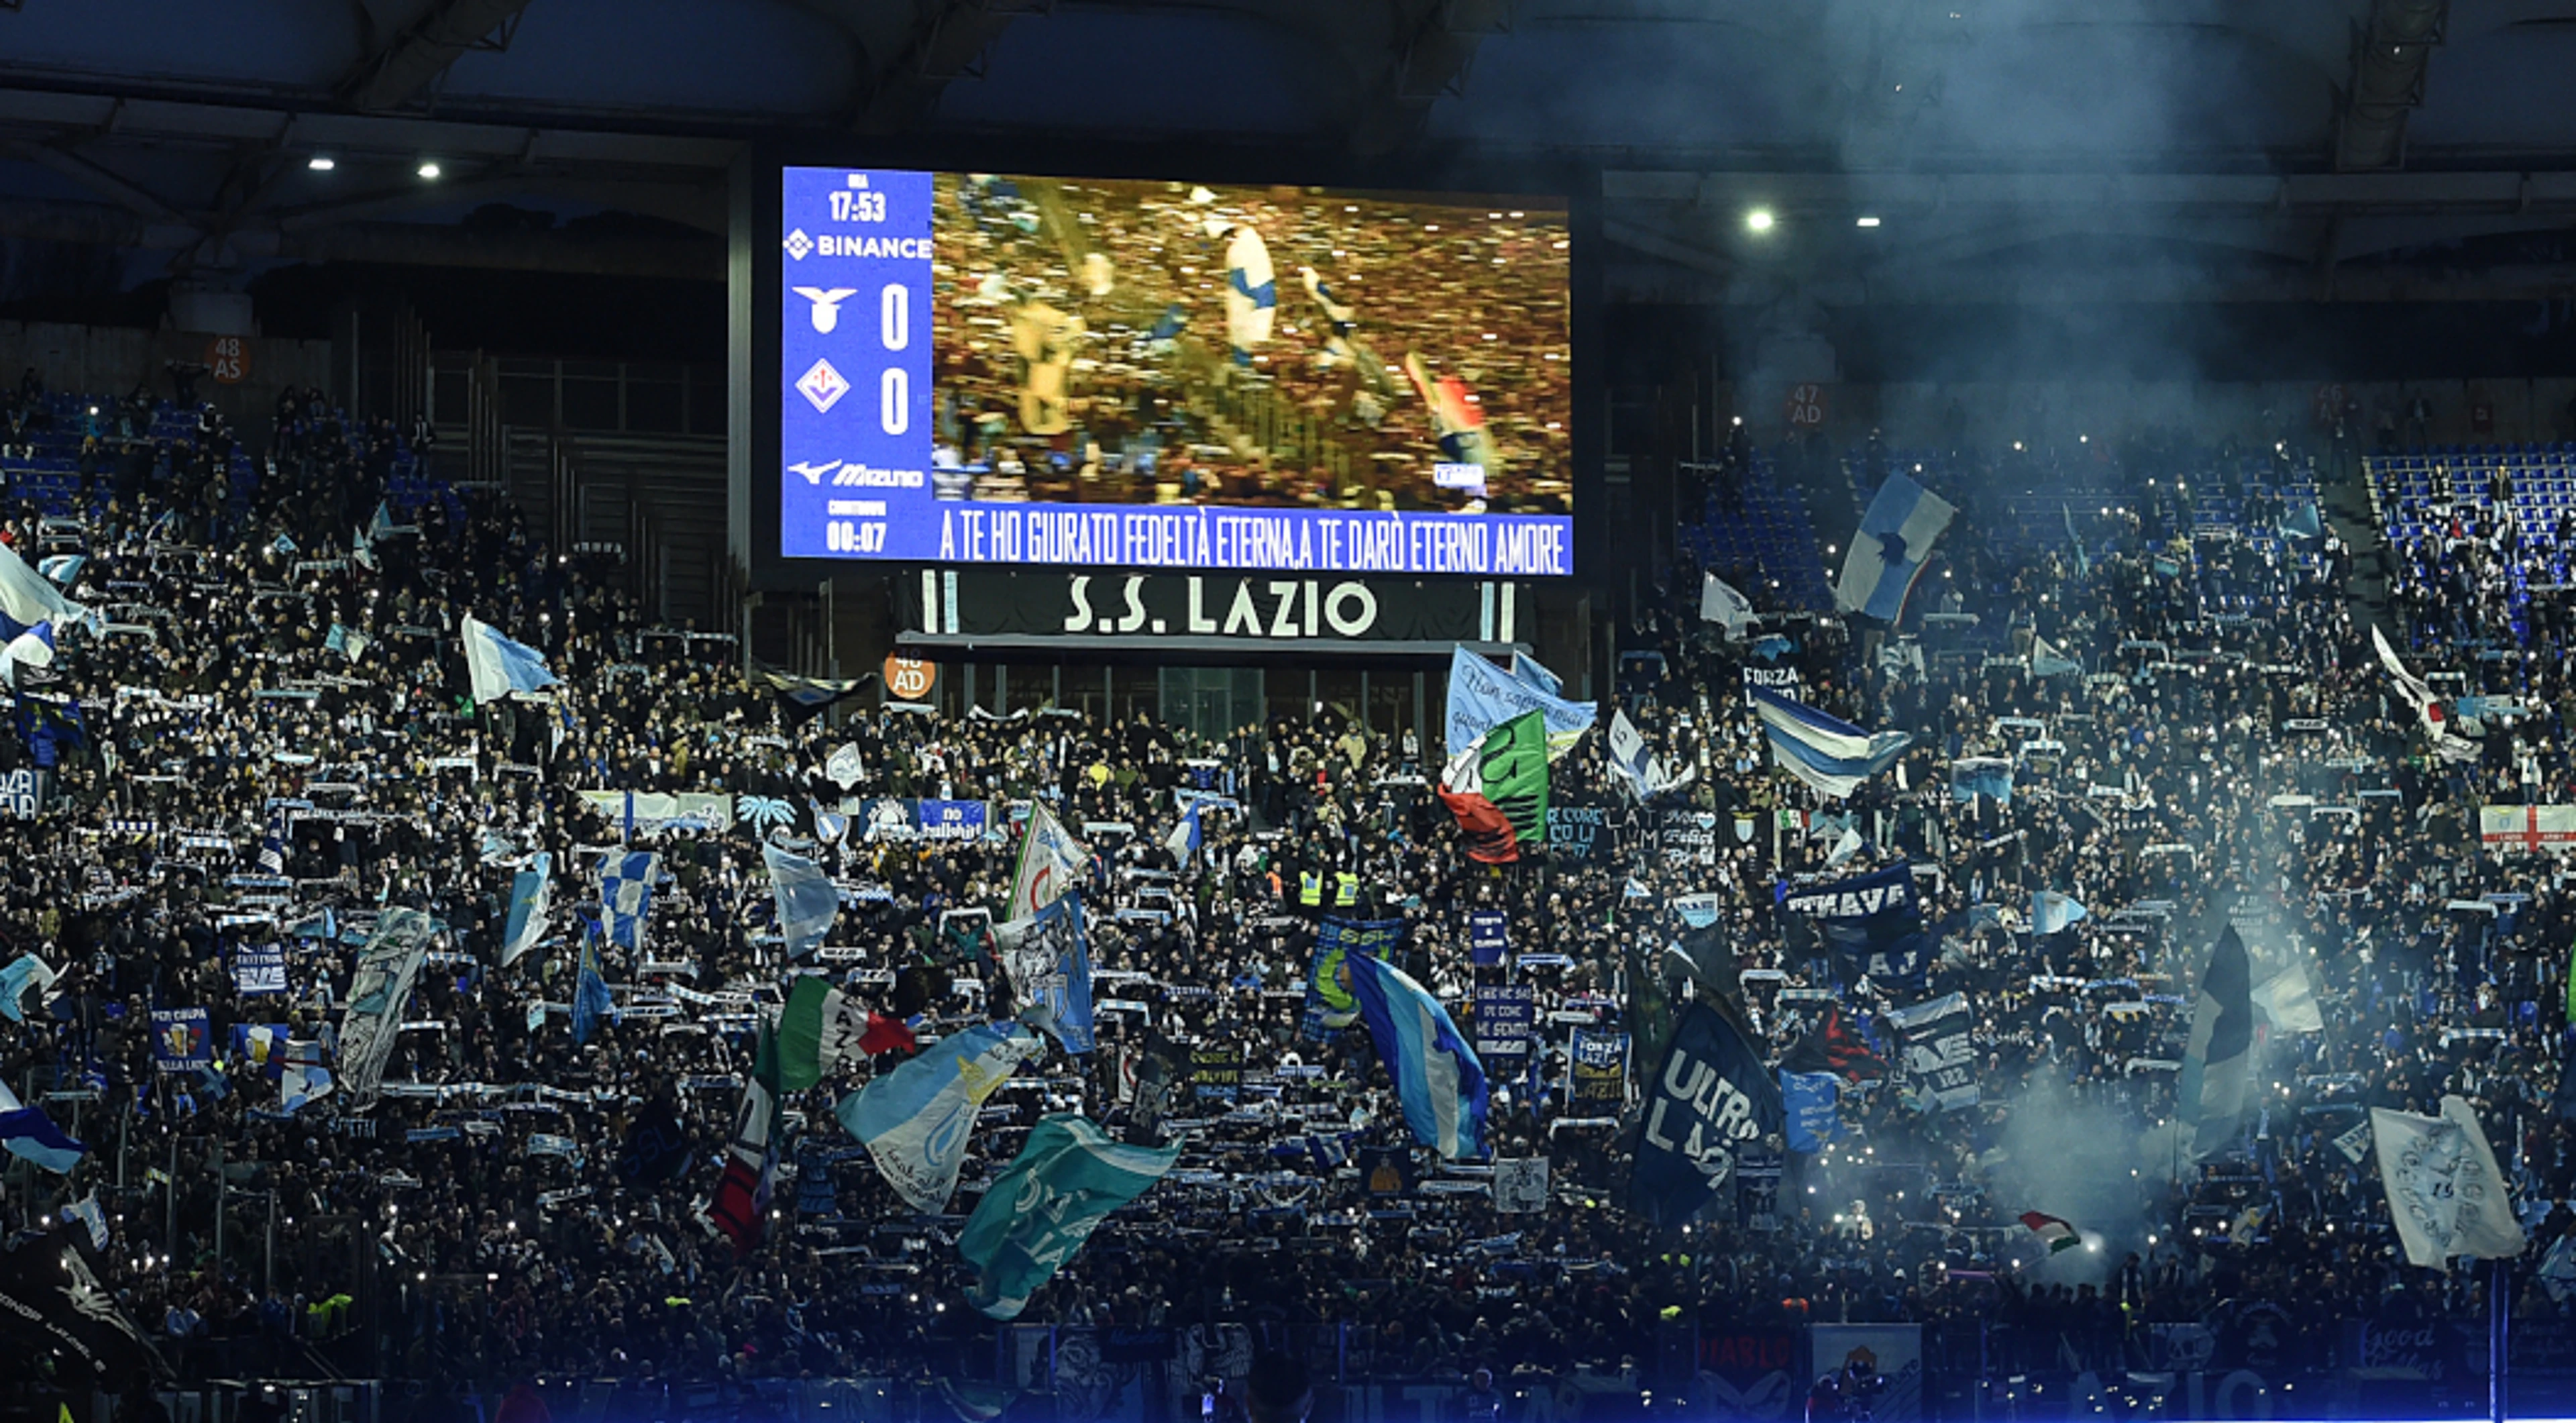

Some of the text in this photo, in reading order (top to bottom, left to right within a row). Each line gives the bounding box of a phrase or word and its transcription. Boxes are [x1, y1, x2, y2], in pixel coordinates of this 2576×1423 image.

[829, 191, 885, 223] 17:53
[818, 235, 932, 259] BINANCE
[881, 283, 908, 350] 0
[215, 337, 241, 357] 48
[213, 358, 241, 379] AS
[881, 368, 908, 435] 0
[1793, 384, 1819, 404] 47
[1791, 404, 1822, 423] AD
[827, 521, 887, 553] 00:07
[940, 509, 955, 561] A
[960, 510, 985, 562] TE
[990, 511, 1021, 562] HO
[1027, 512, 1118, 564] GIURATO
[1124, 506, 1211, 566] FEDELTÀ
[1318, 519, 1342, 570] TE
[1348, 511, 1405, 571] DARÒ
[1411, 521, 1488, 572] ETERNO
[1494, 523, 1564, 574] AMORE
[1064, 575, 1378, 637] S.S. LAZIO
[893, 670, 924, 691] AD
[1743, 666, 1799, 686] FORZA
[943, 807, 963, 821] no
